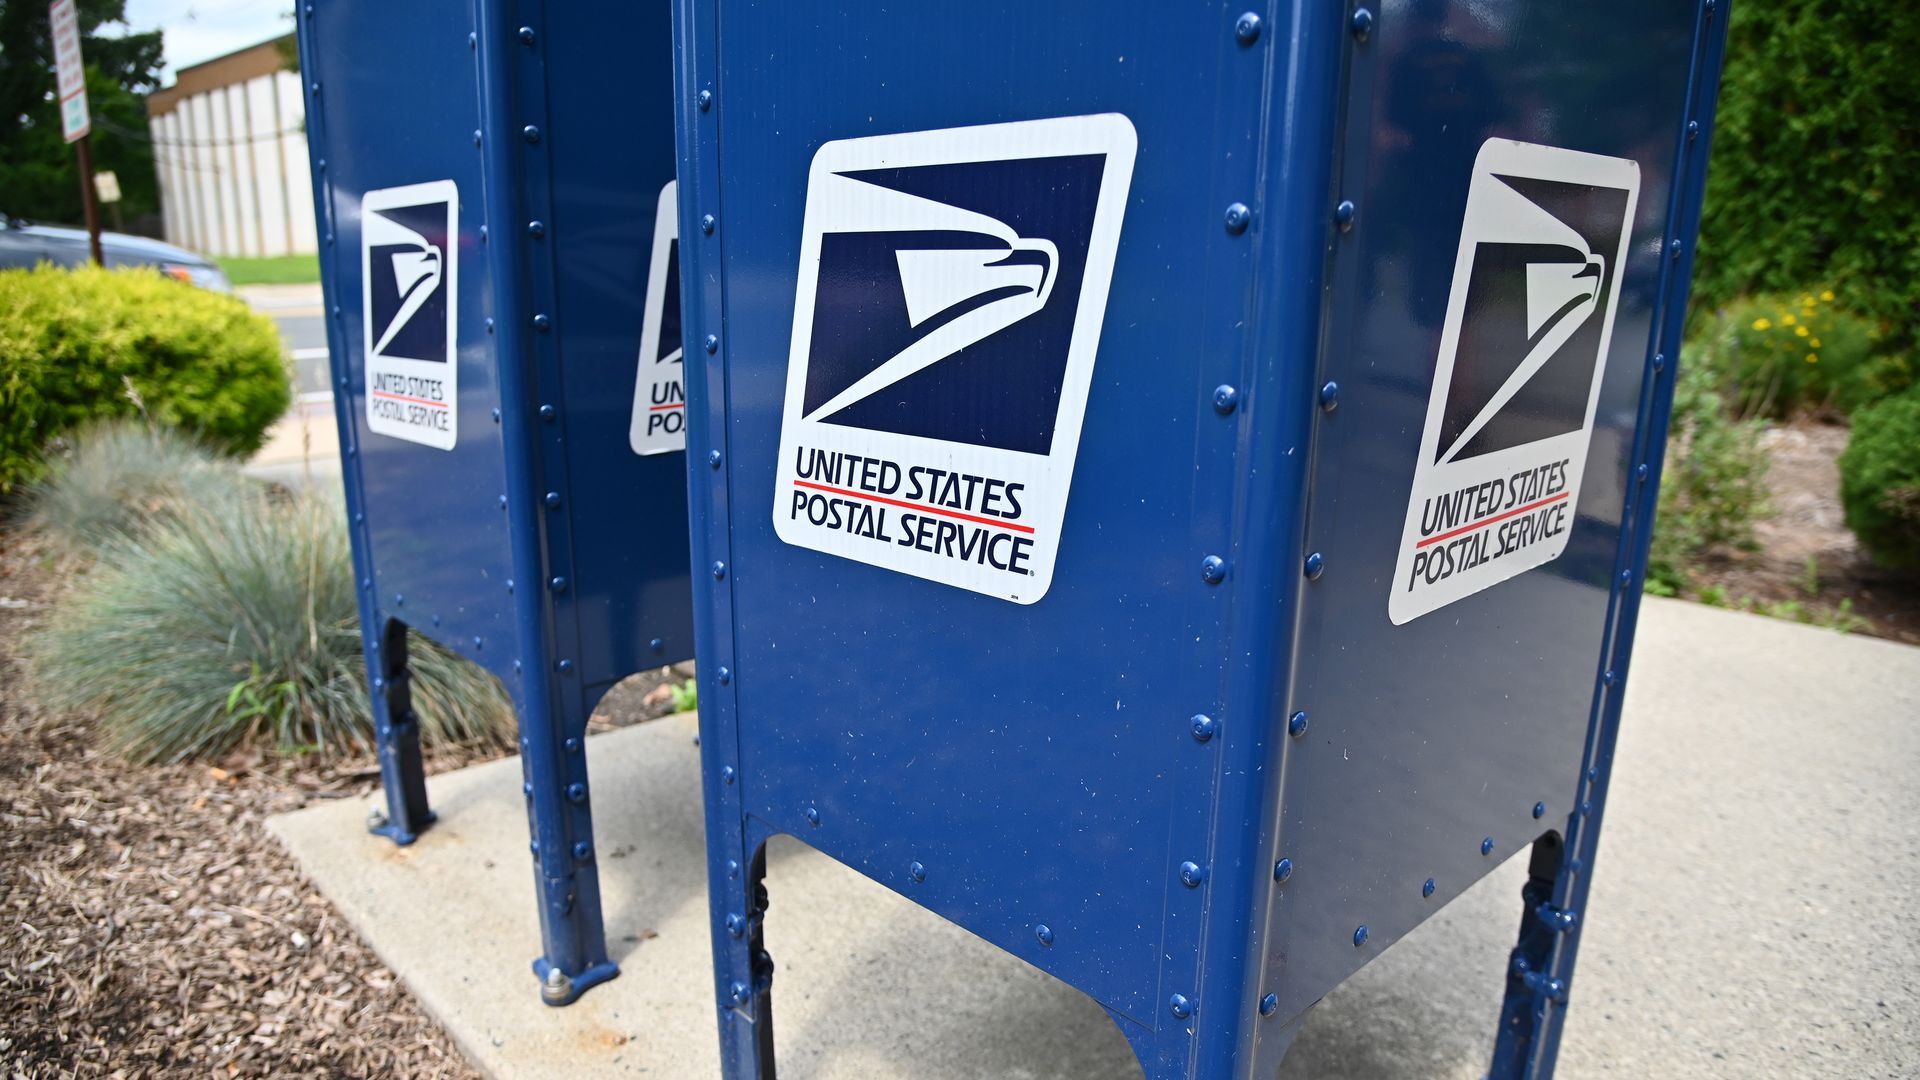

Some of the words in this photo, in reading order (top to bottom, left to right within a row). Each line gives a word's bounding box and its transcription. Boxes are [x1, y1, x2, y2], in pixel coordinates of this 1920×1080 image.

[373, 372, 406, 393] UNITED
[408, 377, 443, 401] STATES
[373, 398, 406, 423] POSTAL
[408, 405, 449, 431] SERVICE
[647, 411, 686, 437] PO
[796, 446, 902, 495] UNITED
[906, 465, 1025, 520] STATES
[1420, 478, 1505, 537] UNITED
[1504, 458, 1569, 509] STATES
[791, 490, 891, 543] POSTAL
[897, 513, 1035, 576] SERVICE
[1408, 529, 1490, 592] POSTAL
[1493, 502, 1568, 560] SERVICE
